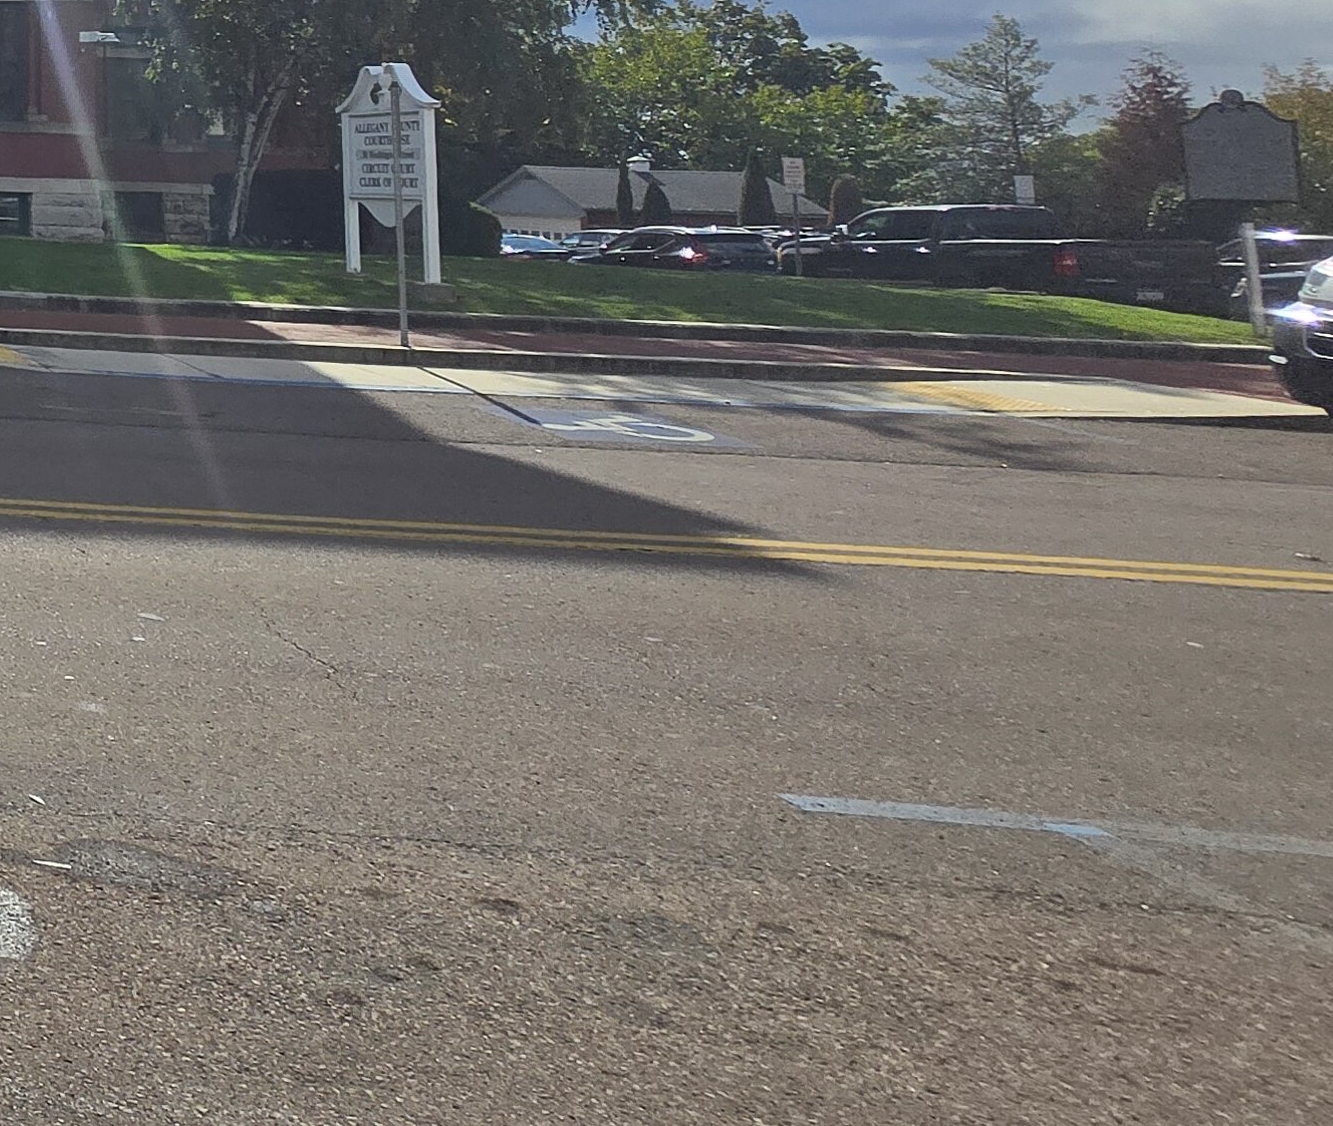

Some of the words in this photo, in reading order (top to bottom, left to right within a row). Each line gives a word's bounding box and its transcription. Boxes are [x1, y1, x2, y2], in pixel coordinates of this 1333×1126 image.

[354, 122, 389, 133] ALLEGANY
[364, 135, 410, 146] COURTHSE
[362, 164, 389, 174] CIRCUIT
[359, 177, 381, 187] CLERK
